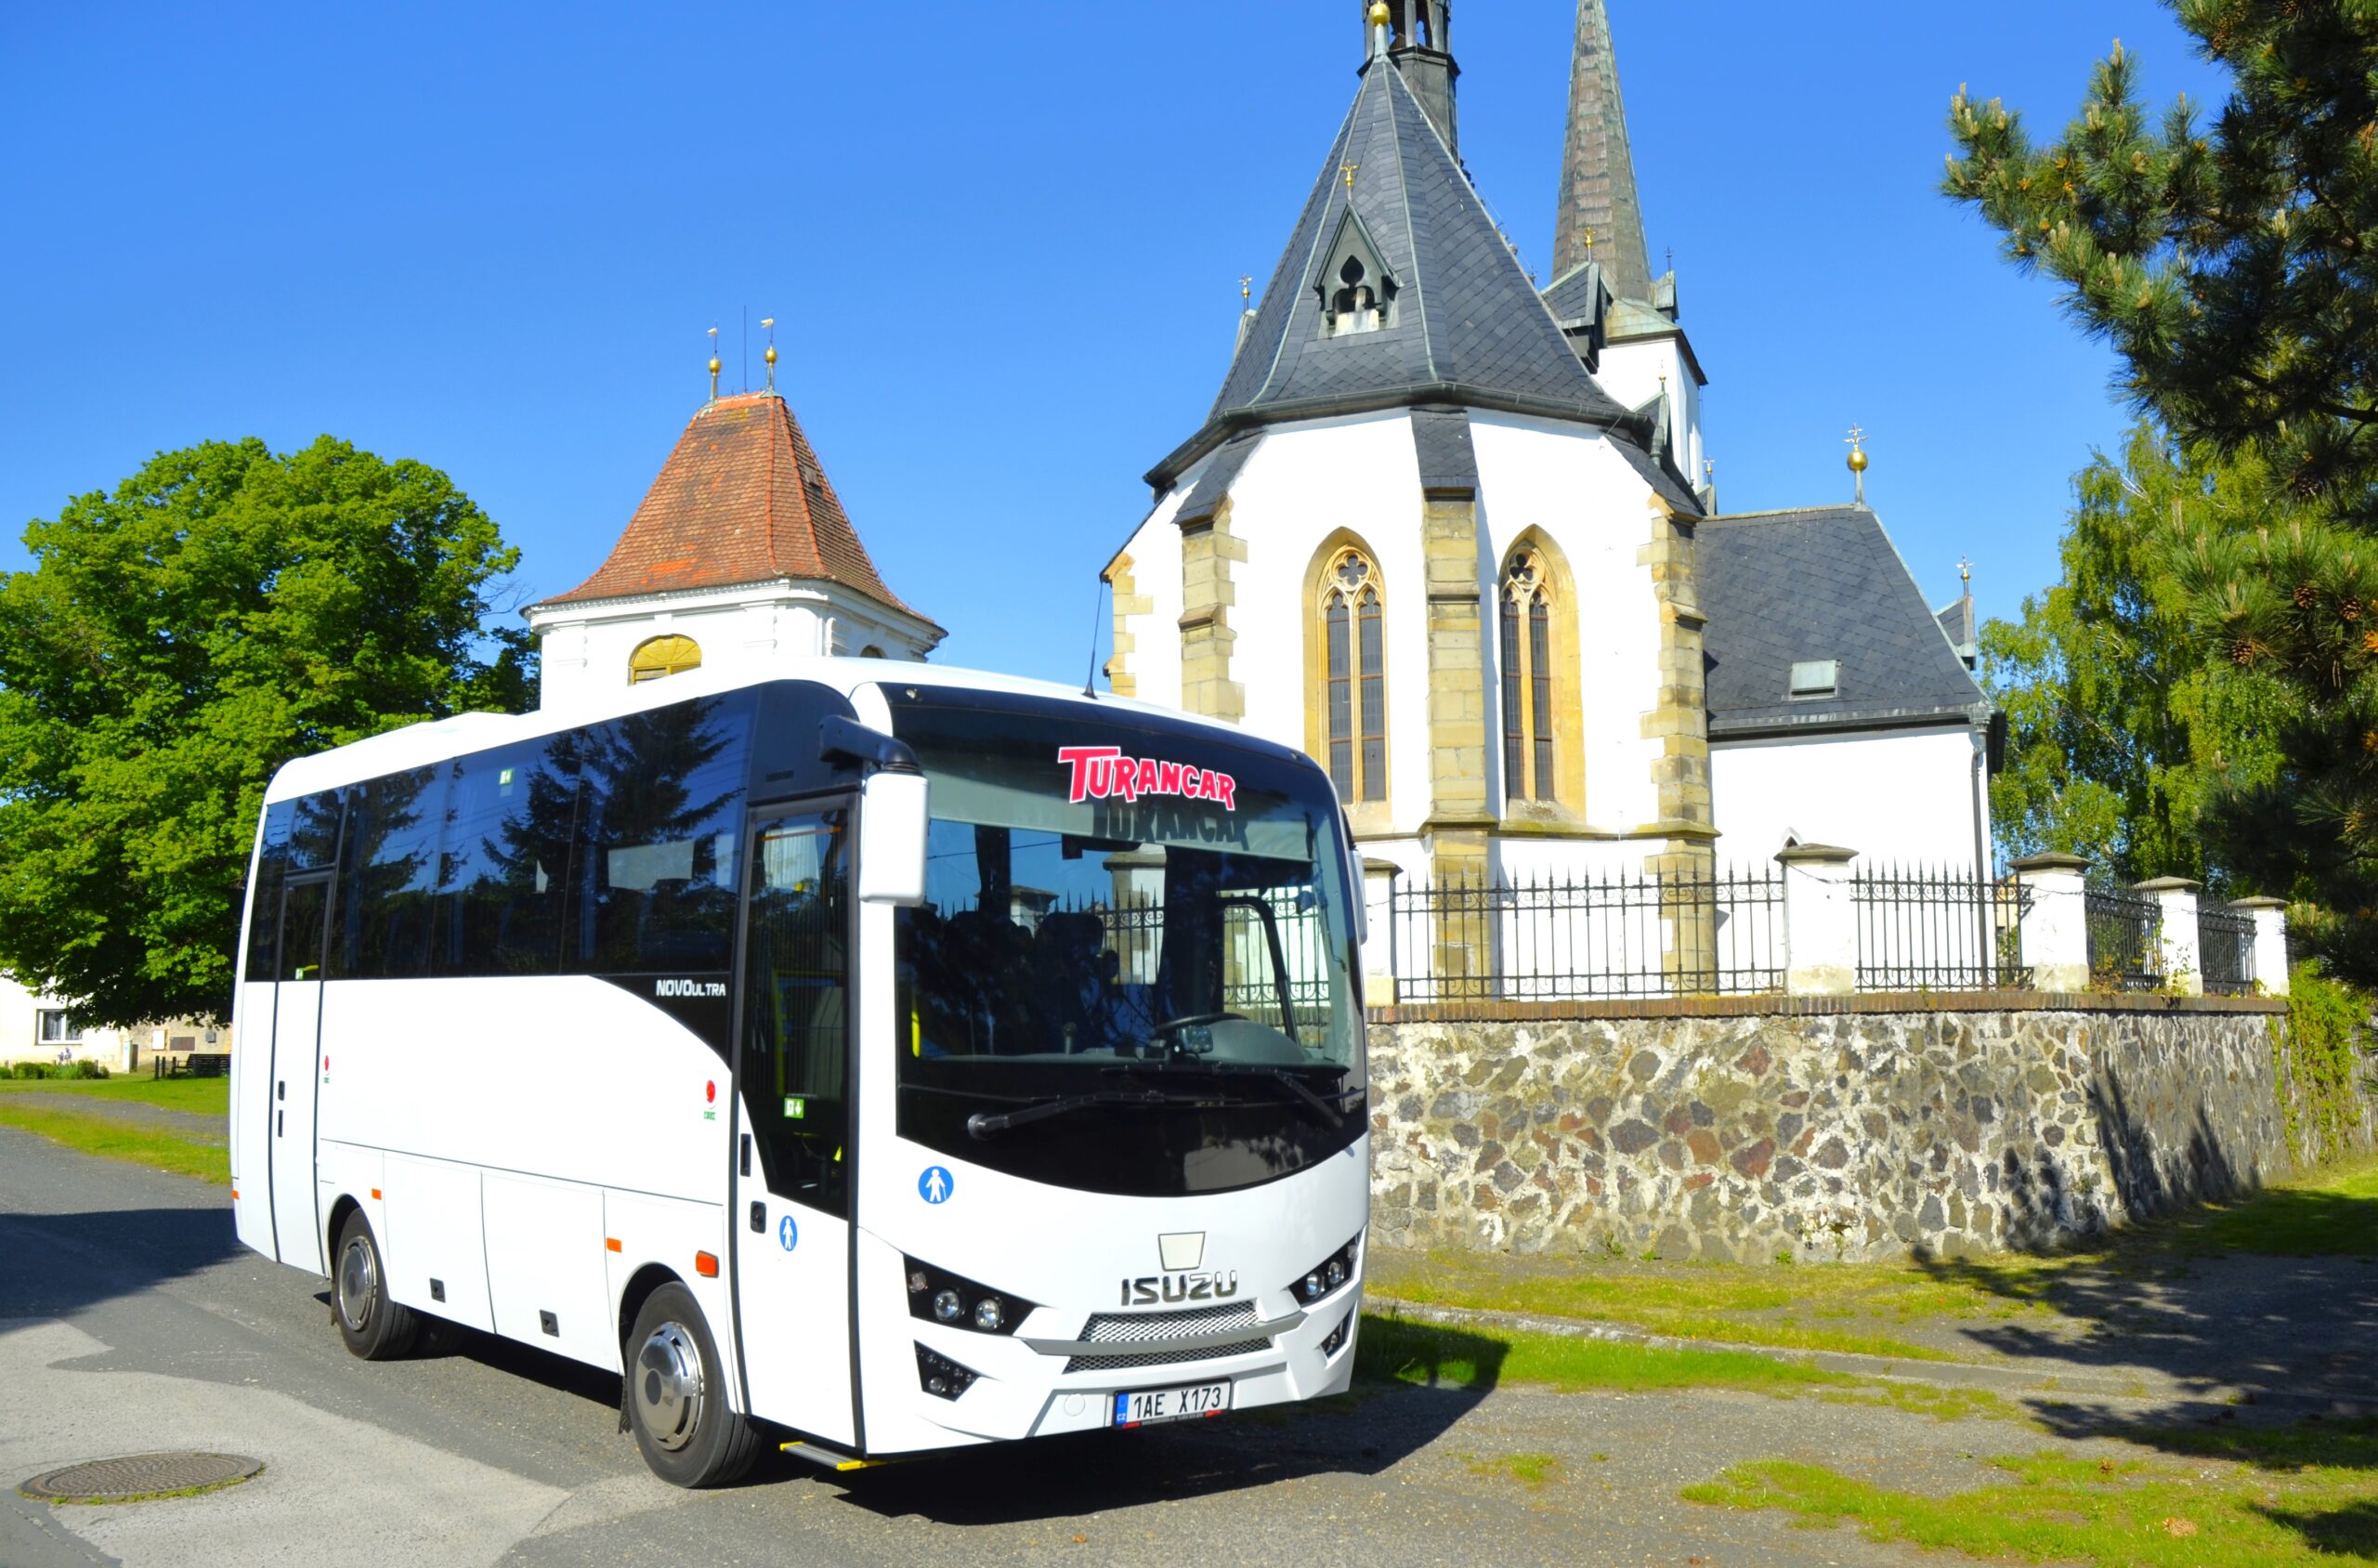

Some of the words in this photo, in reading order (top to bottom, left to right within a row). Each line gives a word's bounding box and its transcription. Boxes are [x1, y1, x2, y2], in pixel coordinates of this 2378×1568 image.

[1057, 746, 1236, 811] TURANCAR
[1120, 1269, 1238, 1307] ISUZU
[1117, 1413, 1127, 1421] CZ
[1133, 1393, 1166, 1419] 1AE
[1179, 1386, 1222, 1414] X173
